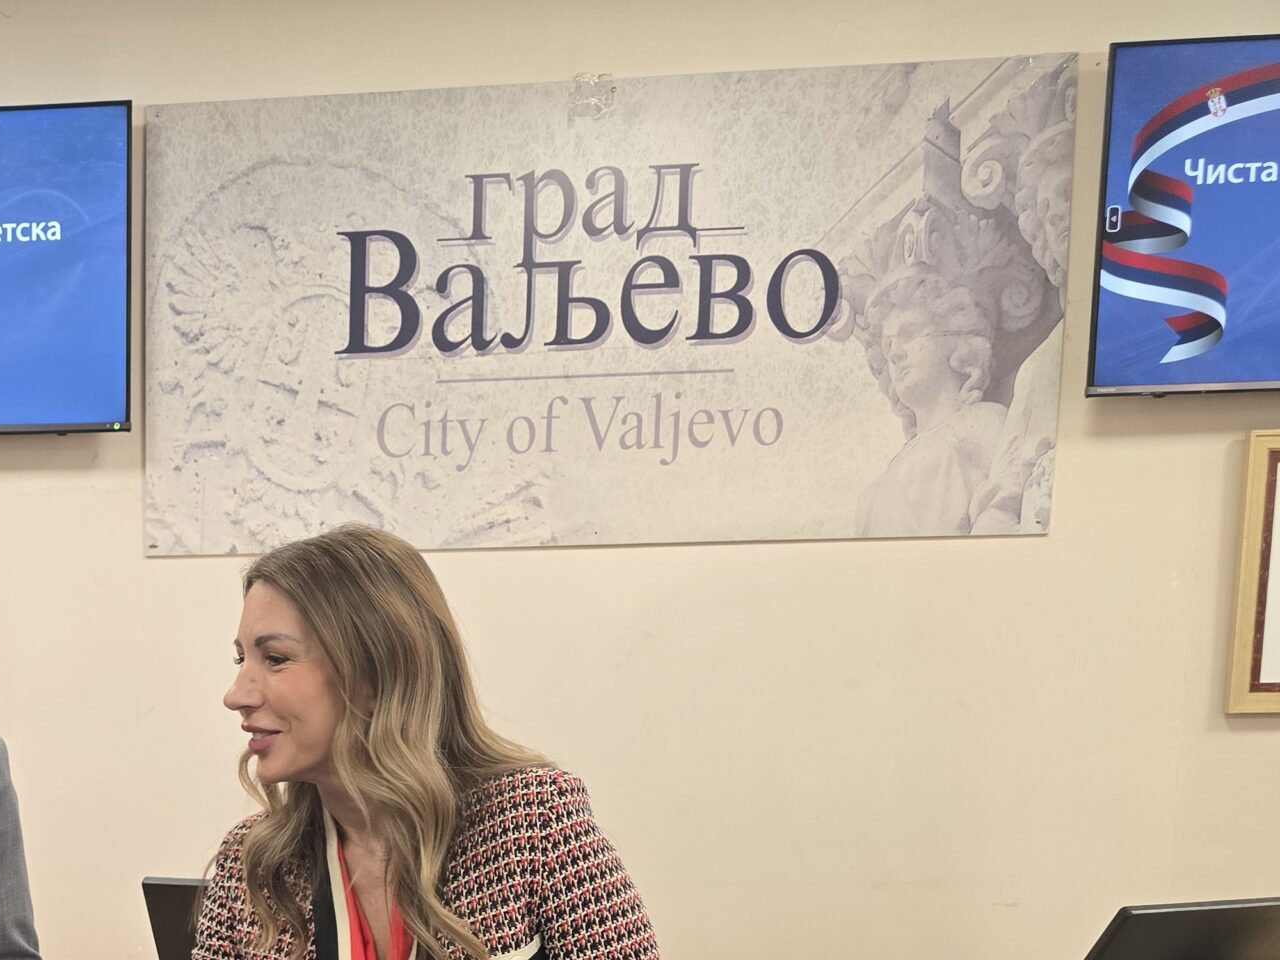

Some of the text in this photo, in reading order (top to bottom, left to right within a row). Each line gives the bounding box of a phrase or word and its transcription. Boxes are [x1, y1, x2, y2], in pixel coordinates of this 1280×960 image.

[464, 162, 702, 264] град
[1184, 158, 1278, 185] Чиста
[334, 228, 842, 358] Ваљево
[376, 392, 784, 471] City of Valjevo
